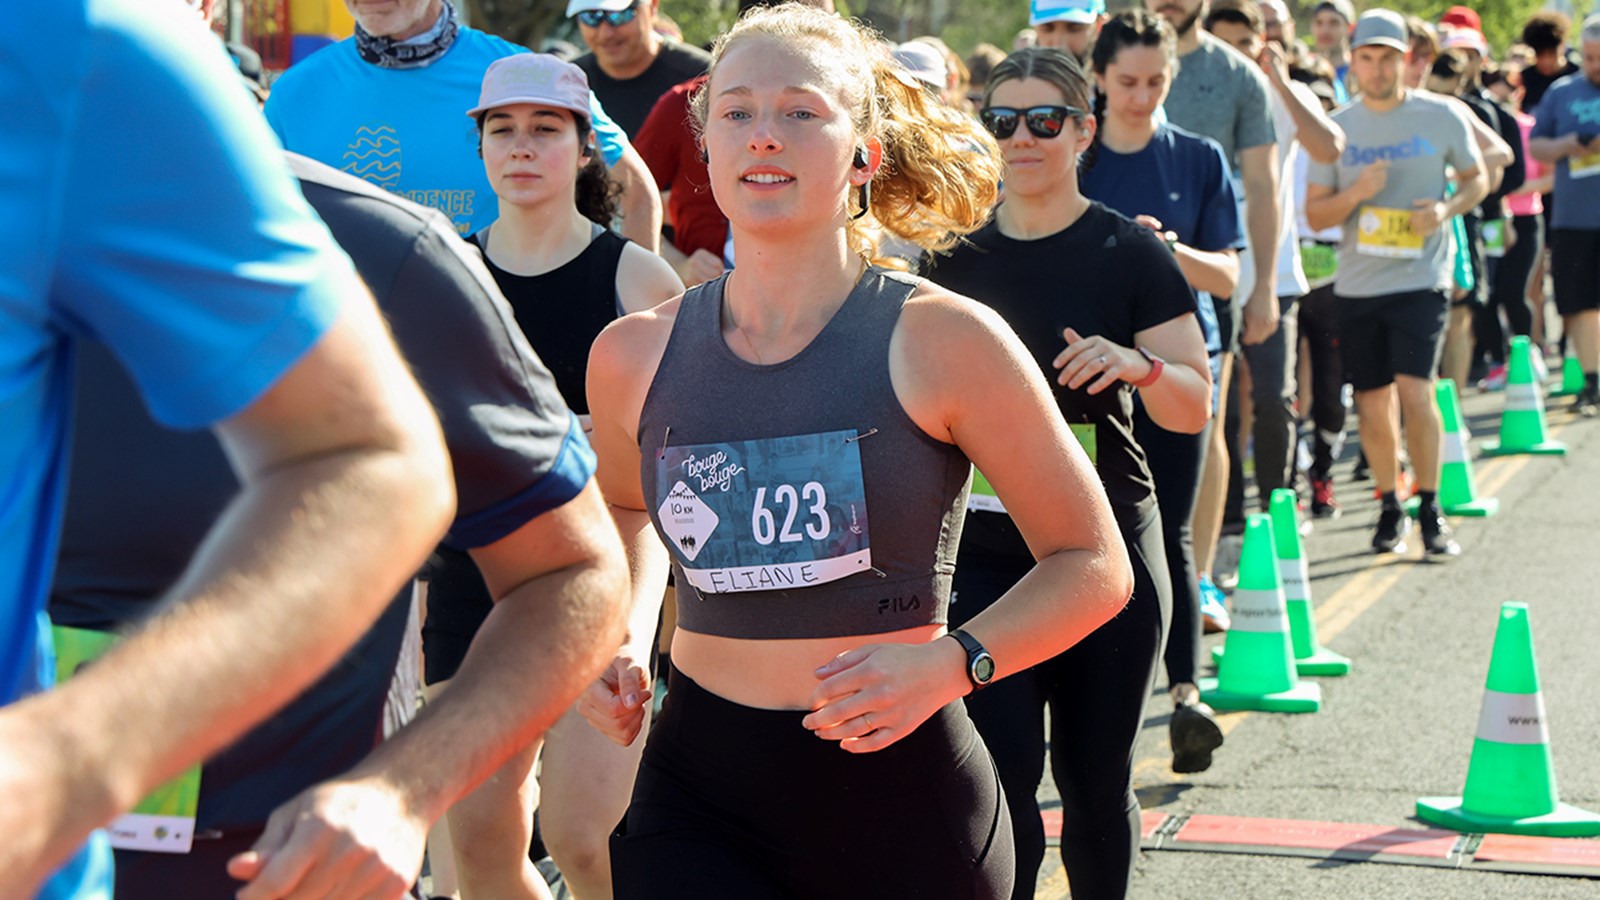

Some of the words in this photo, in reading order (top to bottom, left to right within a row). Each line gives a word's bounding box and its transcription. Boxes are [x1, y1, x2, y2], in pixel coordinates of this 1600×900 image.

[681, 451, 727, 477] bouge
[694, 463, 746, 492] bouge
[670, 503, 682, 515] 10
[752, 481, 831, 545] 623
[878, 595, 921, 614] FILA
